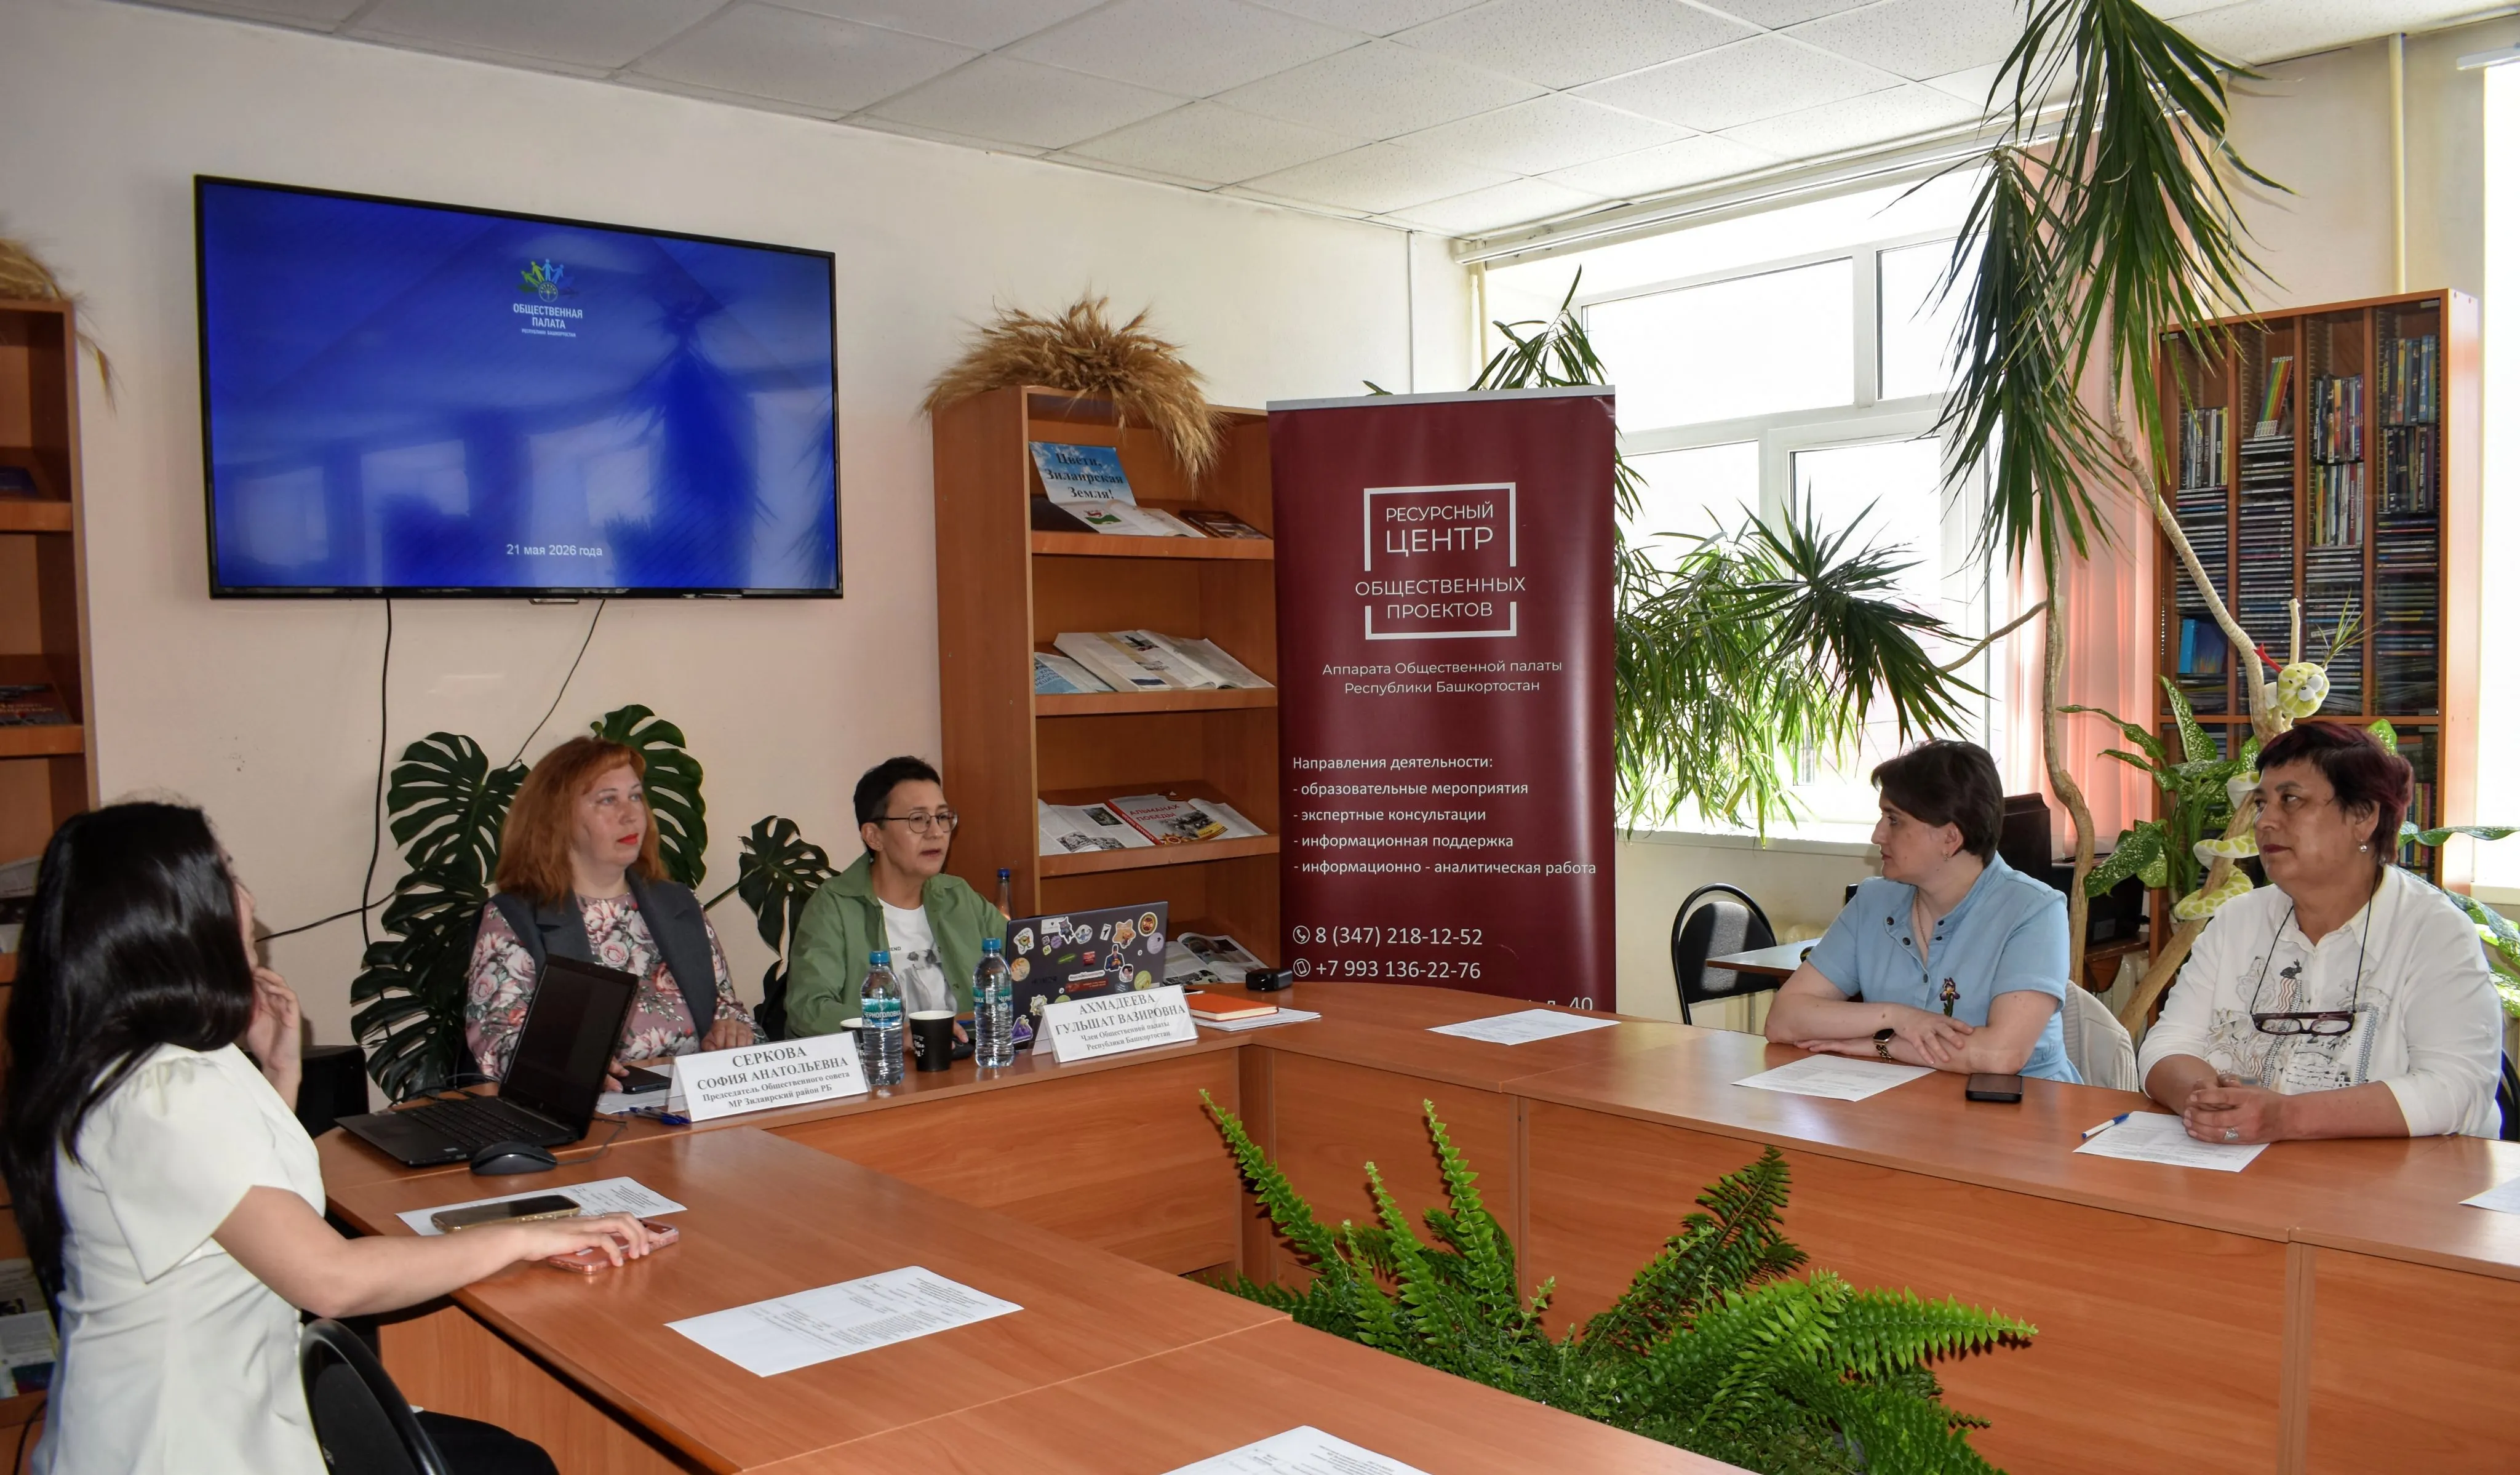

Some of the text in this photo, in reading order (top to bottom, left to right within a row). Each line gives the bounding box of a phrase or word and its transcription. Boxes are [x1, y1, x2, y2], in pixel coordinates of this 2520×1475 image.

[513, 303, 583, 319] ОБЩЕСТВЕННАЯ
[532, 317, 565, 329] ПАЛАТА
[1056, 453, 1102, 468] Цвети,
[1045, 469, 1123, 485] Зилаирская
[1068, 487, 1114, 500] Земля!
[1387, 501, 1493, 522] РЕСУРСНЫЙ
[1387, 527, 1493, 557] ЦЕНТР
[506, 544, 519, 554] 21
[549, 545, 576, 555] 2026
[580, 548, 602, 557] года
[1355, 577, 1525, 598] ОБЩЕСТВЕННЫХ
[1388, 602, 1492, 618] ПРОЕКТОВ
[1323, 660, 1561, 677] Аппарата Общественной палаты
[1346, 682, 1539, 696] Республики Башкортостан
[1294, 757, 1492, 771] Направления деятельности:
[1302, 783, 1427, 797] образовательные
[1432, 785, 1528, 796] мероприятия
[1130, 804, 1180, 815] АЛЬМАНАХ
[1136, 812, 1176, 821] ПОБЕДЫ
[1302, 812, 1384, 823] экспертные
[1389, 811, 1485, 823] консультации
[1302, 834, 1427, 849] информационная
[1433, 837, 1513, 849] поддержка
[1303, 860, 1421, 875] информационно
[1435, 863, 1540, 873] аналитическая
[1546, 862, 1596, 876] работа
[1316, 926, 1482, 947] 8 (347) 218-12-52
[1317, 961, 1480, 978] +7 993 136-22-76
[1080, 994, 1155, 1015] АХМАДЕЕВА
[1055, 1004, 1186, 1035] ГУЛЬШАТ ВАЗИРОВНА
[1099, 1025, 1145, 1039] Общественной
[1146, 1021, 1170, 1031] палаты
[1087, 1031, 1170, 1051] Республики Башкортостан
[733, 1046, 807, 1067] СЕРКОВА
[698, 1057, 848, 1090] СОФИЯ АНАТОЛЬЕВНА
[703, 1072, 850, 1102] Председатель Общественного совета
[746, 1091, 794, 1106] Зилаирский
[795, 1087, 819, 1098] район
